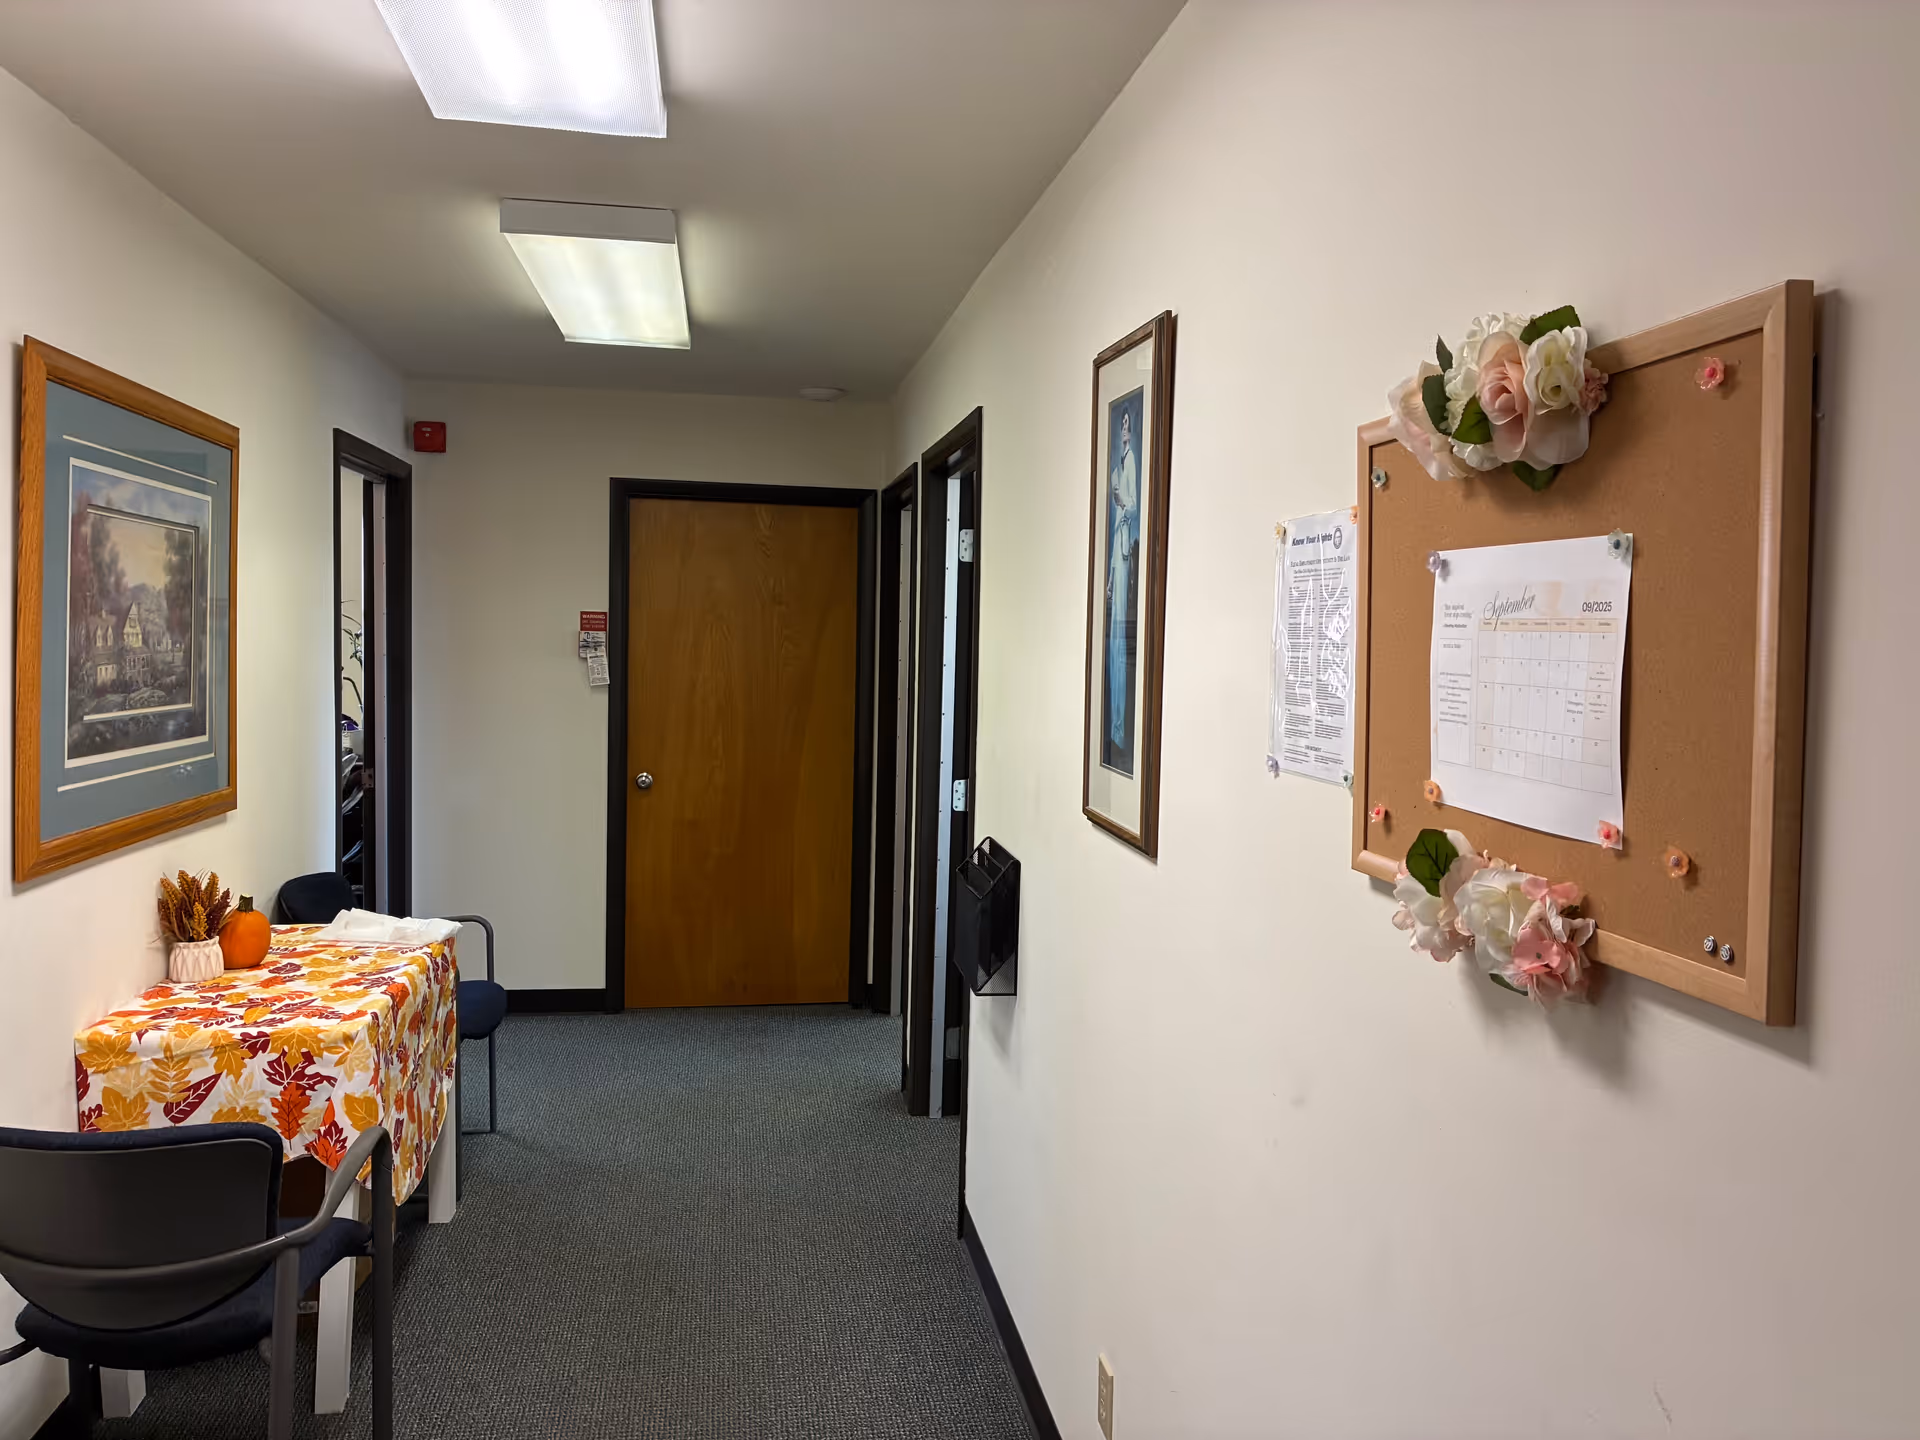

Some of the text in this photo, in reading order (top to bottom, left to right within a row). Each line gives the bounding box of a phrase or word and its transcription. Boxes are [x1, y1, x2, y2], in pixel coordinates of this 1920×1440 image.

[1292, 537, 1306, 546] Know
[1306, 535, 1317, 545] Your
[1483, 585, 1537, 631] September
[1582, 601, 1613, 613] 09/2025
